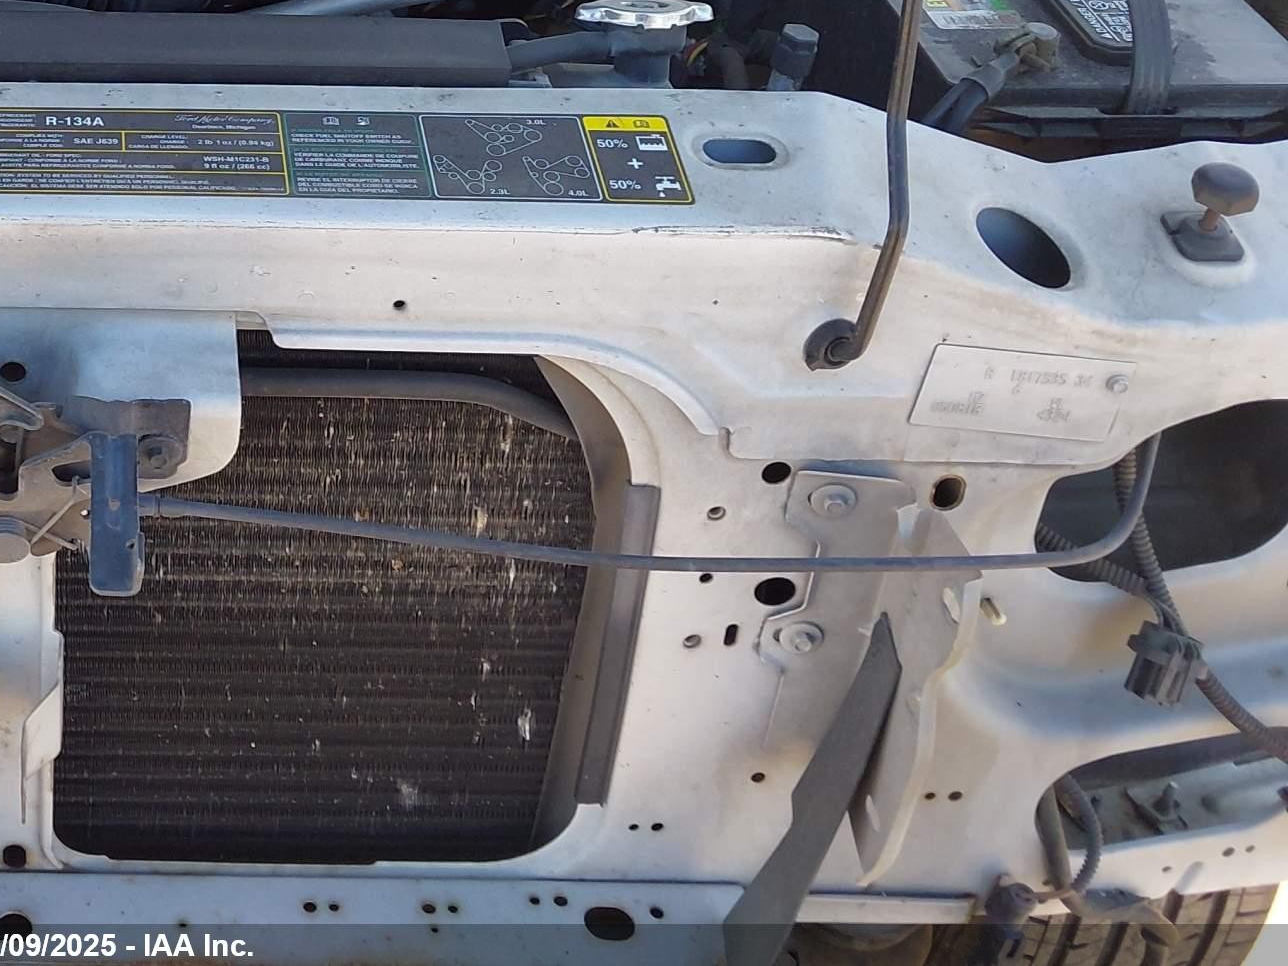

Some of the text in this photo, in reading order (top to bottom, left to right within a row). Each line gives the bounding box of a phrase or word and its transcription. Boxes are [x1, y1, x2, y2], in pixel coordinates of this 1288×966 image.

[45, 116, 104, 126] R-134A
[596, 139, 628, 148] 50%
[609, 180, 642, 189] 50%
